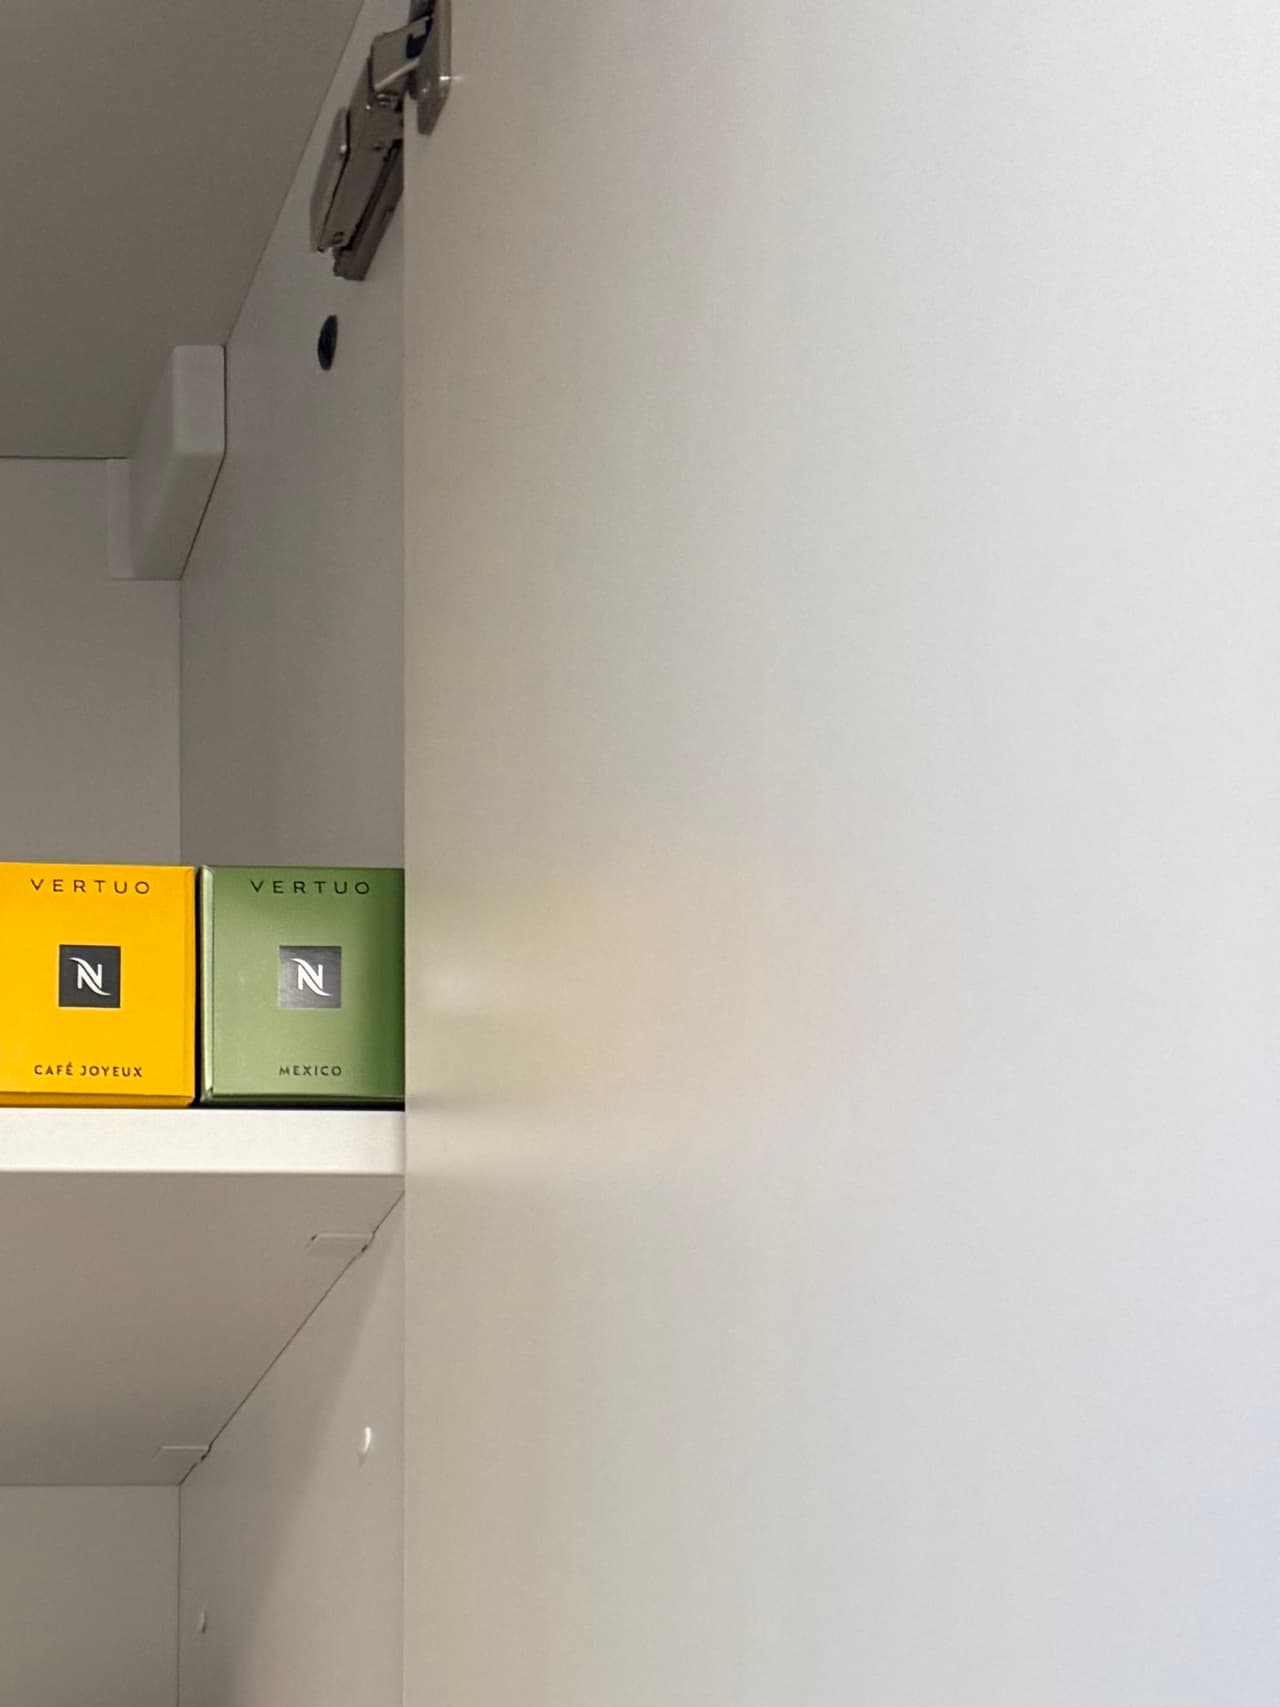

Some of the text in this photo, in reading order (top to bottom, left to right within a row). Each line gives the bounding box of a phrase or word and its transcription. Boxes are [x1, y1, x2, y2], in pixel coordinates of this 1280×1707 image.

[30, 878, 152, 895] VERTUO
[250, 879, 372, 896] VERTUO
[33, 1061, 144, 1078] CAFÉ JOYEUX
[278, 1064, 343, 1078] MEXICO
